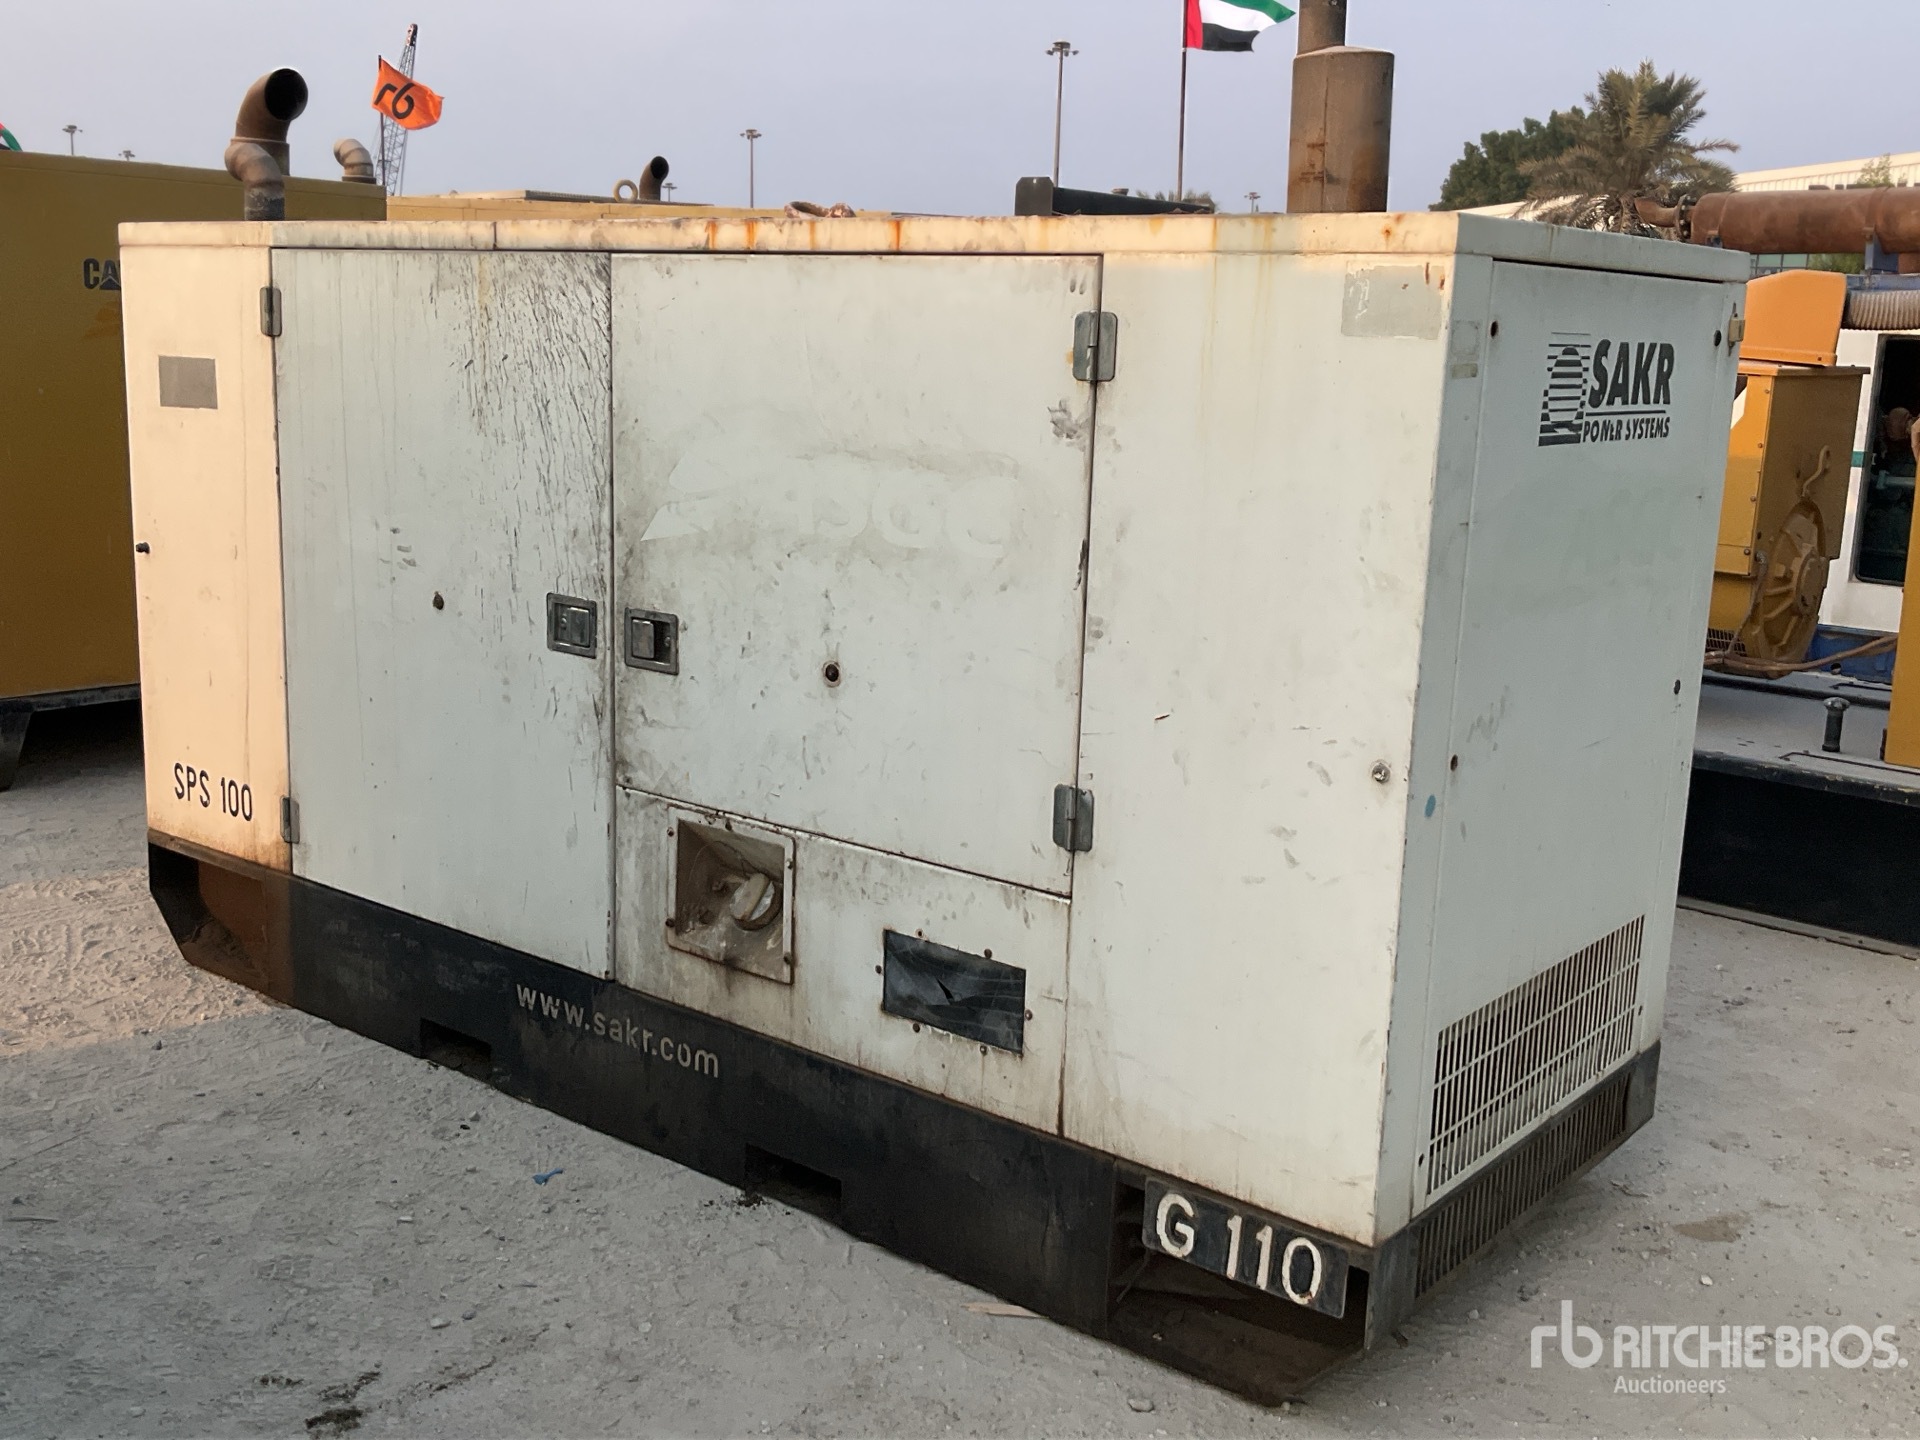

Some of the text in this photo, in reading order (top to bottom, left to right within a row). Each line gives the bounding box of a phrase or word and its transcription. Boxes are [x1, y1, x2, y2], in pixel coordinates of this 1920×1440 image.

[83, 258, 121, 291] CA
[1588, 338, 1675, 409] SAKR
[1624, 416, 1671, 441] SYSTEMS
[174, 762, 253, 822] SPS 100
[516, 983, 720, 1079] www.sakr.com
[1156, 1193, 1323, 1306] G 110
